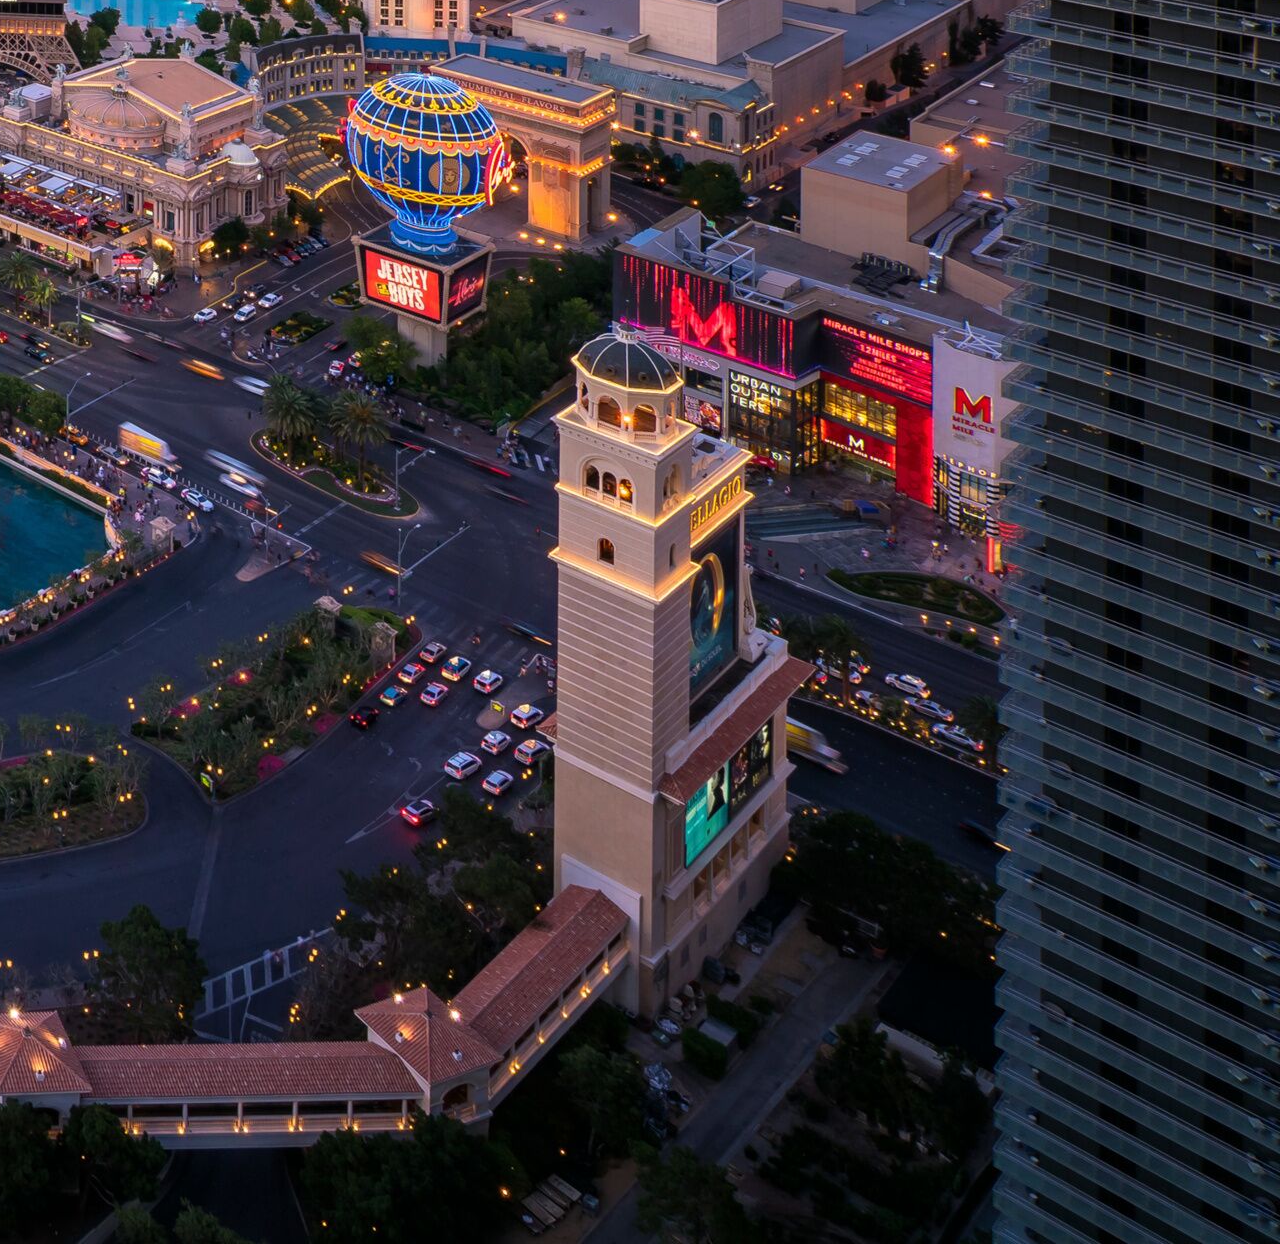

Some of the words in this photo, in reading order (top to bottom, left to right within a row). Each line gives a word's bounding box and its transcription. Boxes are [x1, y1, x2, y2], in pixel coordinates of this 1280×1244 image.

[446, 77, 516, 100] MONUMENTAL
[521, 94, 566, 113] FLAVORS
[377, 258, 428, 292] JERSEY
[387, 281, 425, 311] BOYS
[823, 317, 867, 339] MIRACLE
[868, 333, 893, 349] MILE
[894, 342, 930, 361] SHOPS
[730, 371, 782, 396] URBAN
[730, 383, 783, 408] OUTFIT
[731, 394, 766, 414] TERS
[954, 385, 993, 424] M
[952, 415, 996, 434] MIRACLE
[952, 423, 974, 436] MILE
[824, 438, 852, 452] MIRACLE
[853, 449, 868, 458] MILE
[869, 455, 891, 467] SHOPS
[848, 434, 865, 451] M
[690, 475, 741, 532] ELLAGIO
